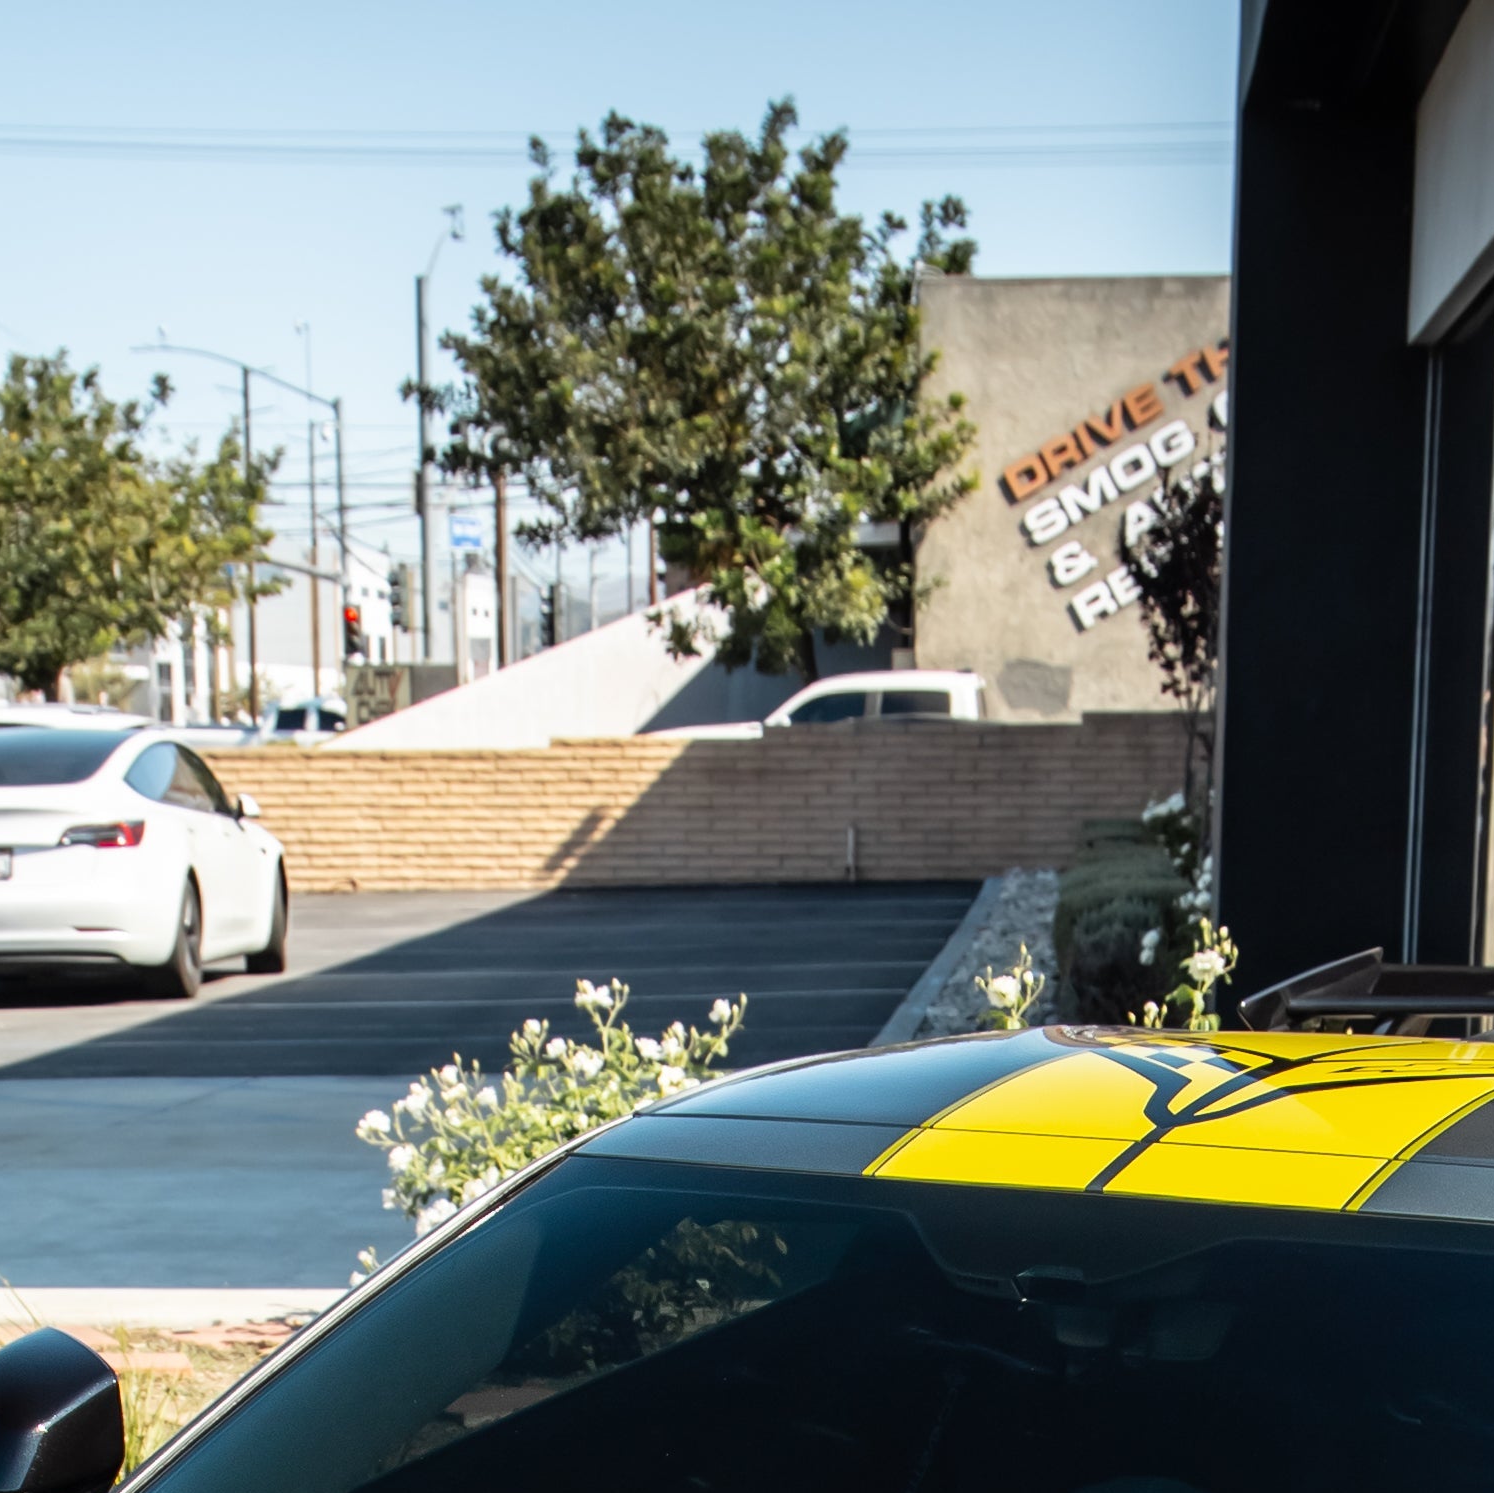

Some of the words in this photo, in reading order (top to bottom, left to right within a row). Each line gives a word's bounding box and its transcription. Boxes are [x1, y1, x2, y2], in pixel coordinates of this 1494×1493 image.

[1003, 382, 1165, 500] DRIVE
[1023, 419, 1196, 545] SMOG
[1050, 540, 1098, 586] &
